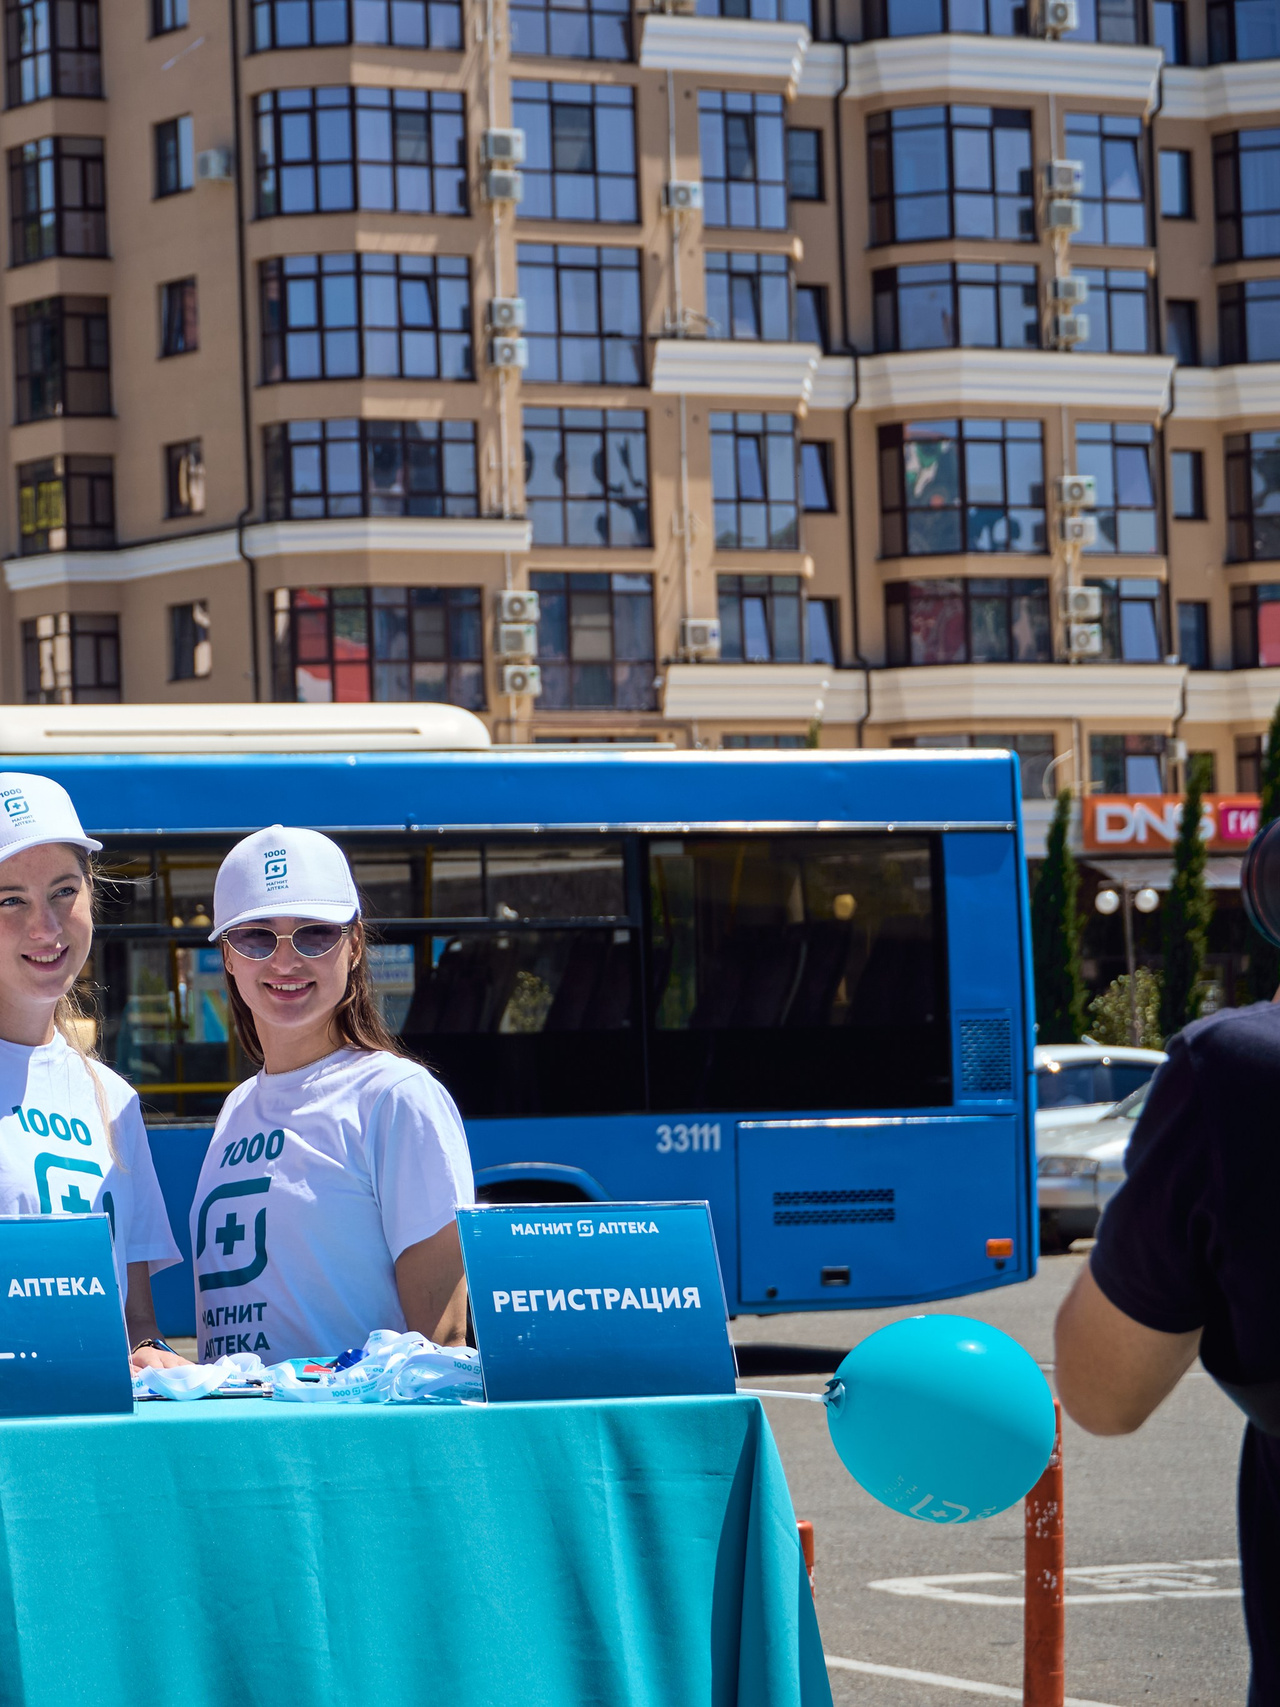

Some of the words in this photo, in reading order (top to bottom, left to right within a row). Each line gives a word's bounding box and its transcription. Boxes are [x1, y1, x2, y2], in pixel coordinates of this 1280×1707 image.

[0, 788, 22, 798] 1000
[14, 819, 36, 828] АПТЕКА
[264, 849, 287, 859] 1000
[266, 879, 289, 887] МАГНИТ
[266, 884, 290, 892] АПТЕКА
[12, 1105, 92, 1146] 1000
[656, 1123, 721, 1153] 33111
[220, 1129, 285, 1168] 1000
[511, 1222, 572, 1235] МАГНИТ
[598, 1221, 659, 1234] АПТЕКА
[8, 1277, 106, 1298] АПТЕКА
[492, 1287, 701, 1313] РЕГИСТРАЦИЯ
[203, 1332, 270, 1361] АПТЕКА
[453, 1361, 472, 1371] 1000
[331, 1390, 351, 1398] 1000
